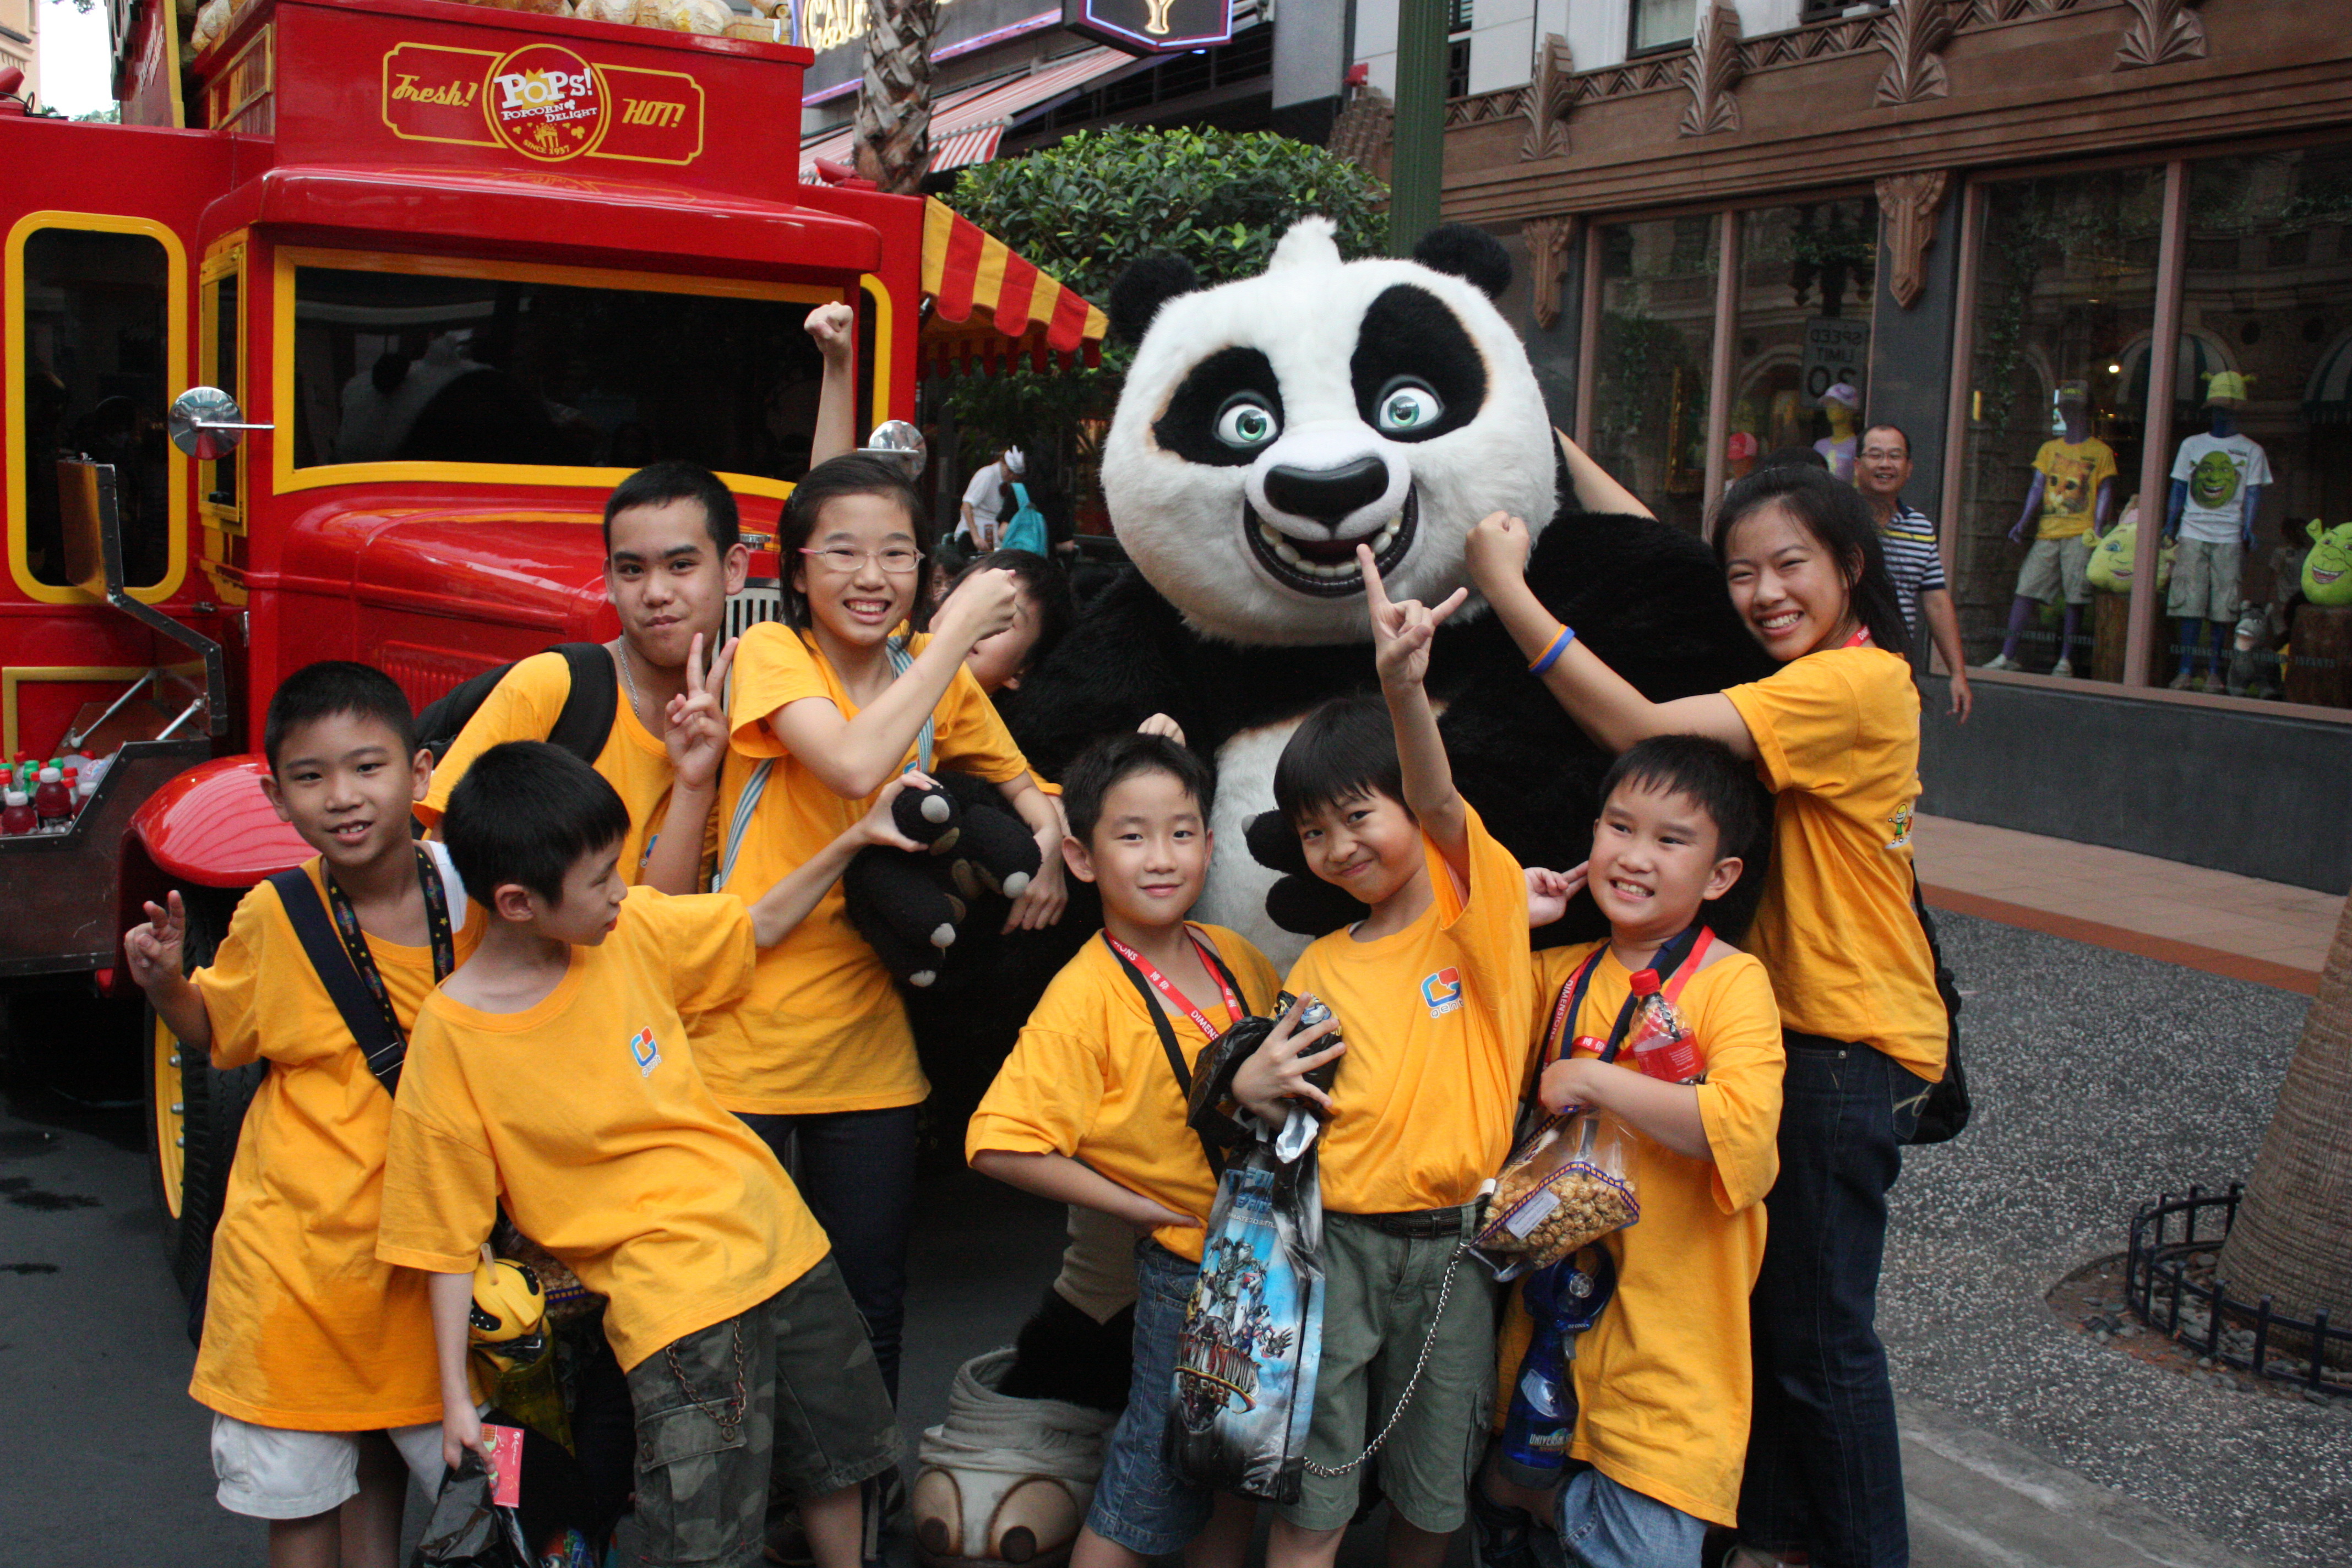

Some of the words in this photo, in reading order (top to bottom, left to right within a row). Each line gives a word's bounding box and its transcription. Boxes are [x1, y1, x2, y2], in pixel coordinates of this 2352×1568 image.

[392, 74, 478, 107] Fresh!
[500, 103, 564, 121] POPCORN
[545, 107, 598, 123] DELIGHT
[622, 98, 686, 128] HOT!
[523, 139, 547, 155] SINCE
[548, 145, 570, 156] 1937
